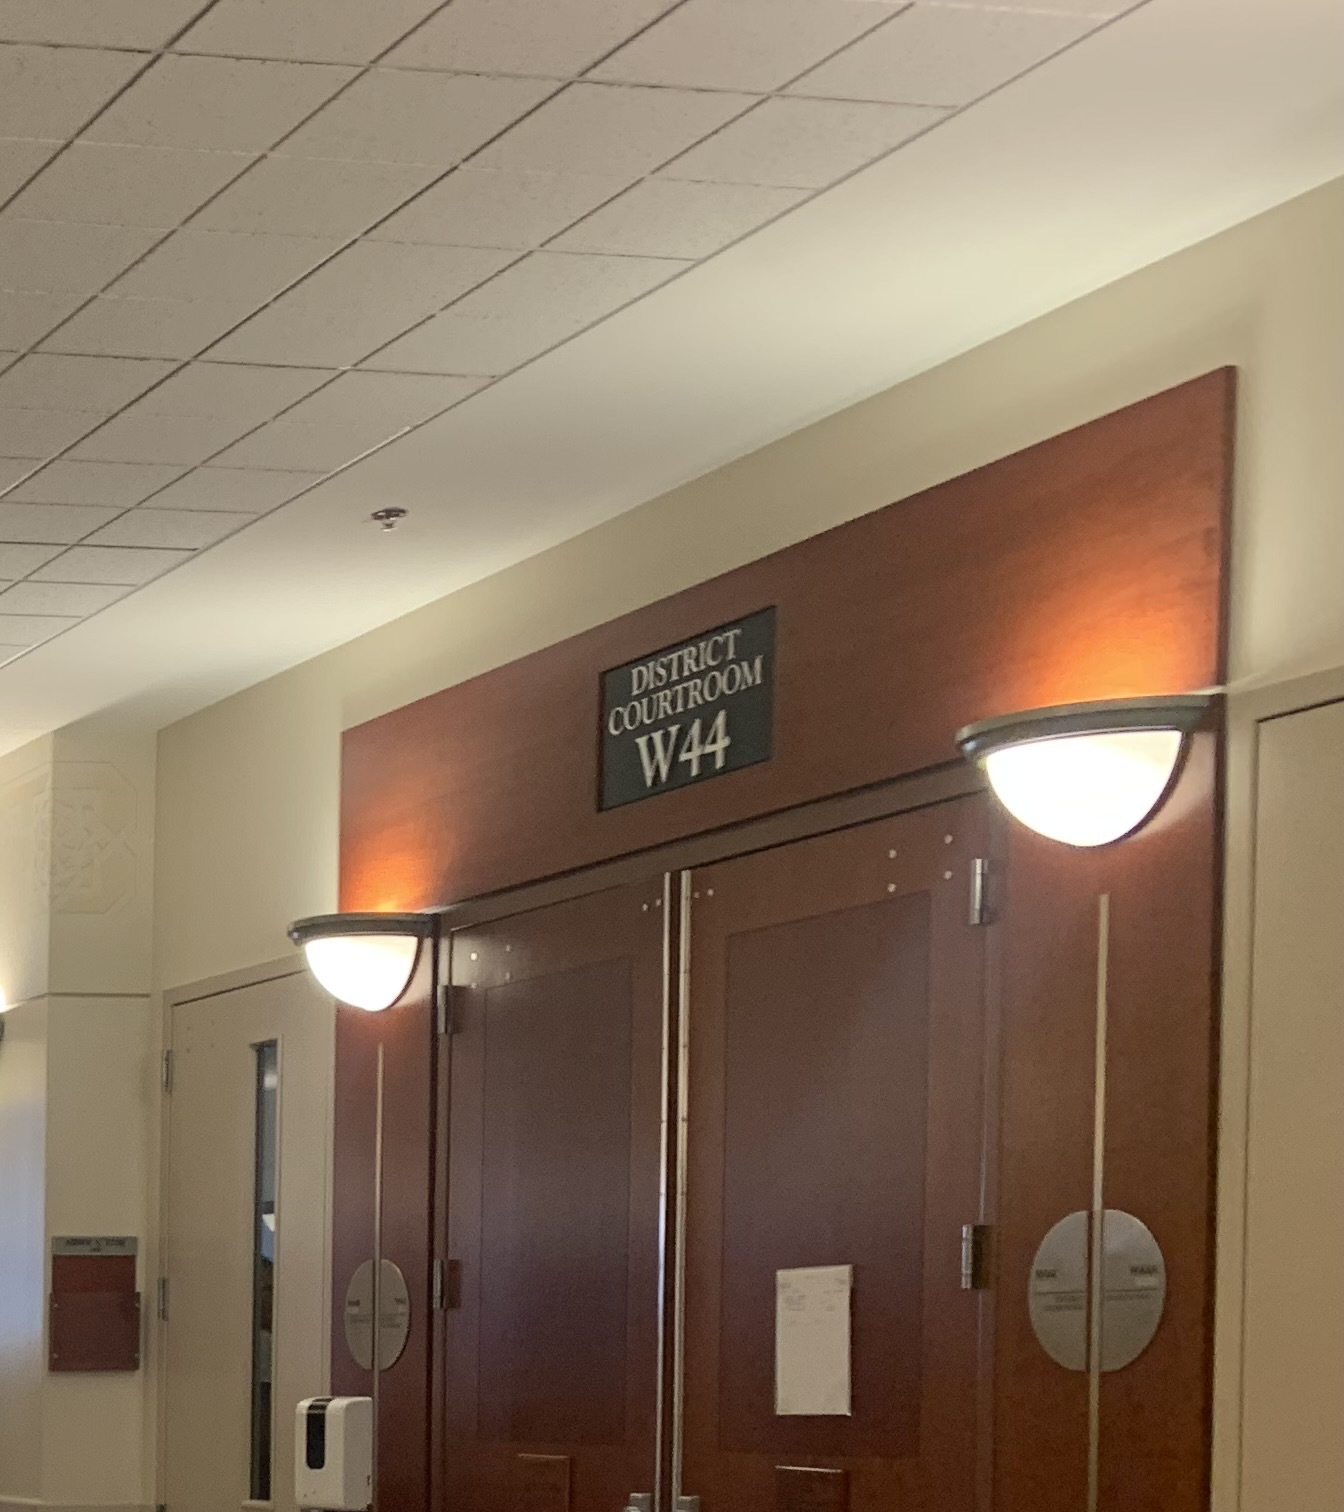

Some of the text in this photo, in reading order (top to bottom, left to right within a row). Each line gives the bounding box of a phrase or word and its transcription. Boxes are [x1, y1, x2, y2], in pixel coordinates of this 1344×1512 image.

[607, 654, 764, 736] COURTROOM
[631, 627, 744, 697] DISTRICT
[633, 708, 732, 788] W44
